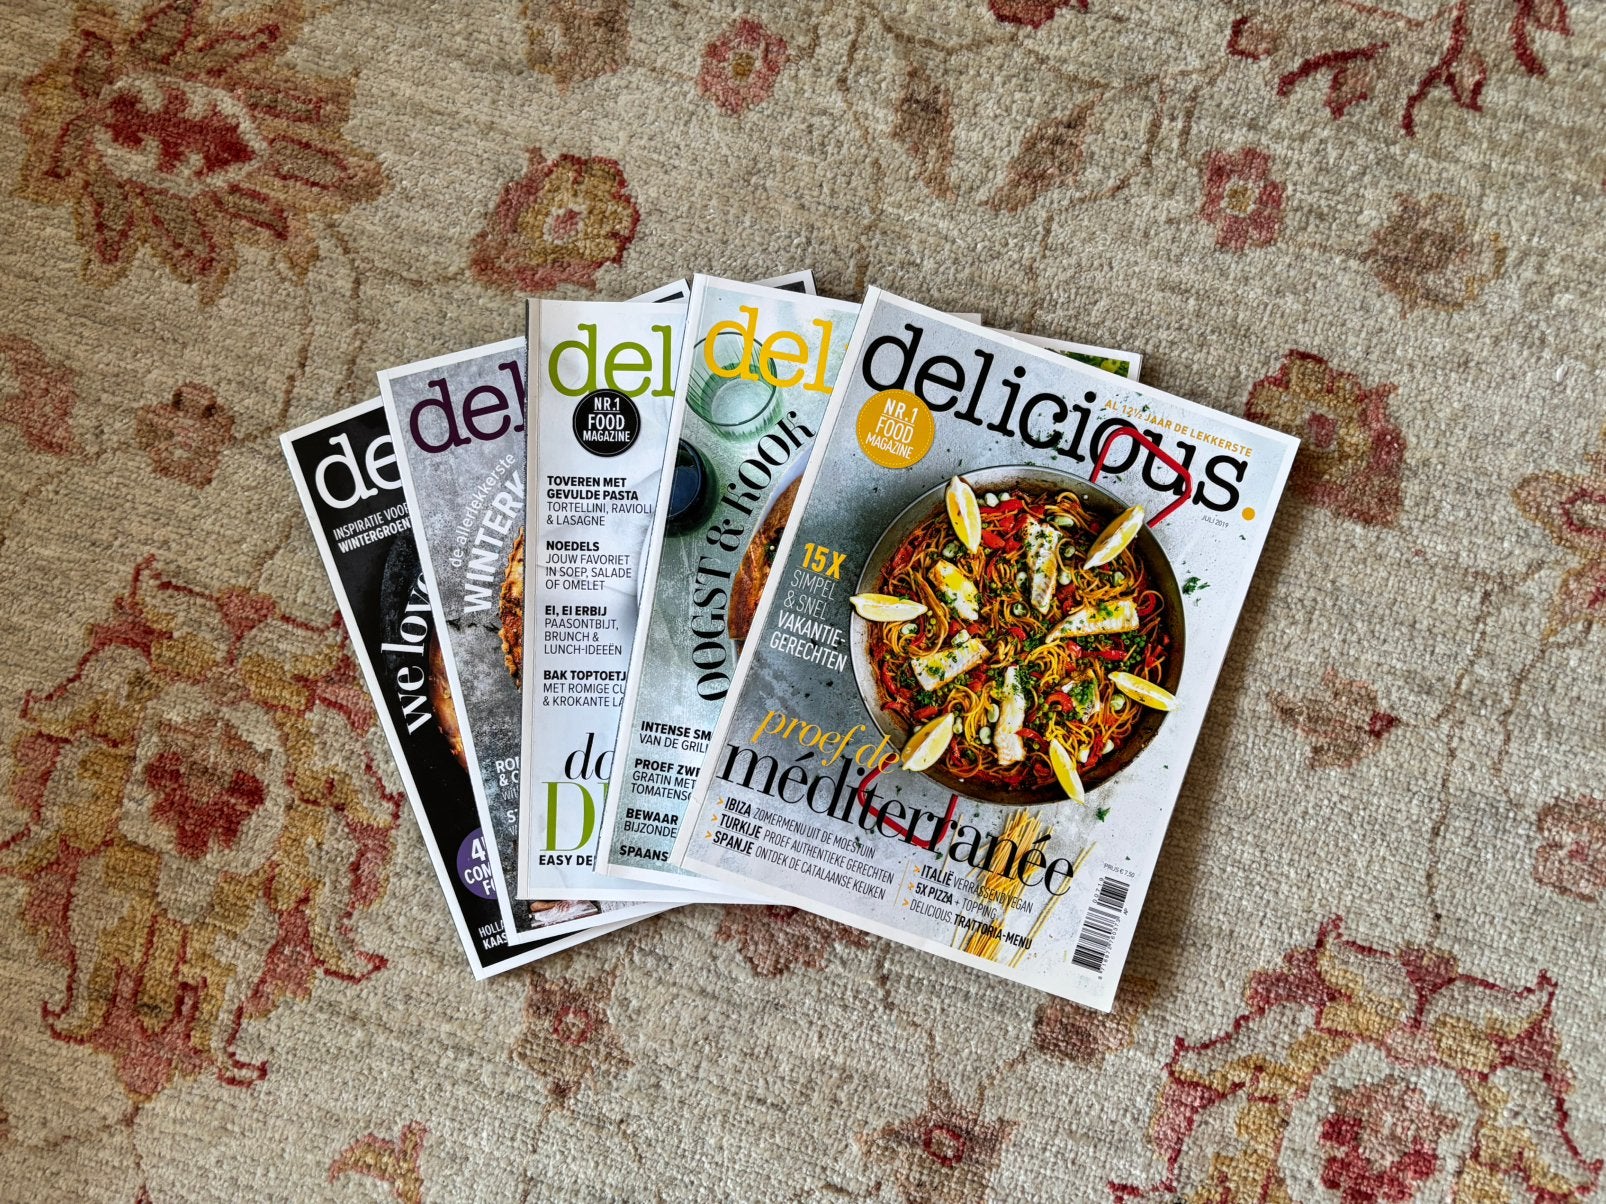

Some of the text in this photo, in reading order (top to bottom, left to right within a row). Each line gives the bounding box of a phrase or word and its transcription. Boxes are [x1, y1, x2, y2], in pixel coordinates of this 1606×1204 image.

[703, 305, 833, 394] del
[548, 323, 675, 398] del
[594, 397, 620, 411] NR.1
[884, 398, 919, 424] NR.1
[588, 413, 625, 430] FOOD
[875, 416, 914, 444] FOOD
[1104, 399, 1118, 411] AL
[1144, 413, 1172, 430] JAAR
[1174, 423, 1188, 435] DE
[1189, 429, 1253, 457] LEKKERSTE
[583, 430, 630, 442] MAGAZINE
[865, 432, 914, 460] MAGAZINE
[315, 433, 403, 509] de
[546, 475, 627, 488] TOVEREN MET
[546, 488, 639, 501] GEVULDE PASTA
[449, 454, 517, 568] de allerlekkerste
[547, 501, 652, 514] TORTELLINI, RAVIOLI
[333, 512, 385, 541] INSPIRATIE
[546, 515, 605, 526] & LASAGNE
[338, 516, 412, 554] WINTERGROEN
[546, 540, 600, 552] NOEDELS
[546, 553, 630, 565] JOUW FAVORIET
[690, 555, 732, 702] OOGST
[720, 410, 816, 518] KOOK
[802, 542, 847, 580] 15X
[545, 566, 632, 578] IN SOEP, SALADE
[545, 579, 605, 591] OF OMELET
[790, 569, 836, 601] SIMPEL
[562, 605, 572, 616] EI
[575, 606, 607, 617] ERBIJ
[783, 590, 827, 620] & SNEL
[545, 618, 619, 631] PAASONTBIJT,
[778, 610, 845, 647] VAKANTIE-
[544, 631, 600, 642] BRUNCH &
[544, 643, 622, 655] LUNCH-IDEEËN
[770, 631, 848, 672] GERECHTEN
[543, 670, 567, 680] BAK
[543, 683, 566, 694] MET
[568, 683, 610, 694] ROMIGE
[396, 665, 433, 735] we
[542, 696, 550, 706] &
[552, 696, 610, 707] KROKANTE
[640, 720, 692, 738] INTENSE
[639, 733, 662, 747] VAN
[664, 737, 678, 749] DE
[751, 710, 900, 774] proef de
[634, 758, 675, 773] PROEF
[632, 770, 673, 786] GRATIN
[625, 807, 679, 825] BEWAAR
[715, 741, 1075, 897] méditerranée
[623, 821, 678, 838] BIJZONDE
[724, 796, 876, 859] IBIZA ZOMERMENU UIT DE MOESTUIN
[619, 845, 669, 862] SPAANS
[719, 813, 895, 885] TURKIJE PROEF AUTHENTIEKE GERECHTEN
[538, 855, 595, 866] EASY DE
[712, 830, 886, 901] SPANJE ONTDEK DE CATALAANSE KEUKEN
[920, 864, 1034, 914] ITALIË VERRASSEND VEGAN
[915, 882, 930, 896] 5X
[927, 886, 953, 905] PIZZA
[962, 898, 998, 919] TOPPING
[953, 913, 1033, 949] TRATTORIA-MENU
[482, 932, 508, 951] KAAS
